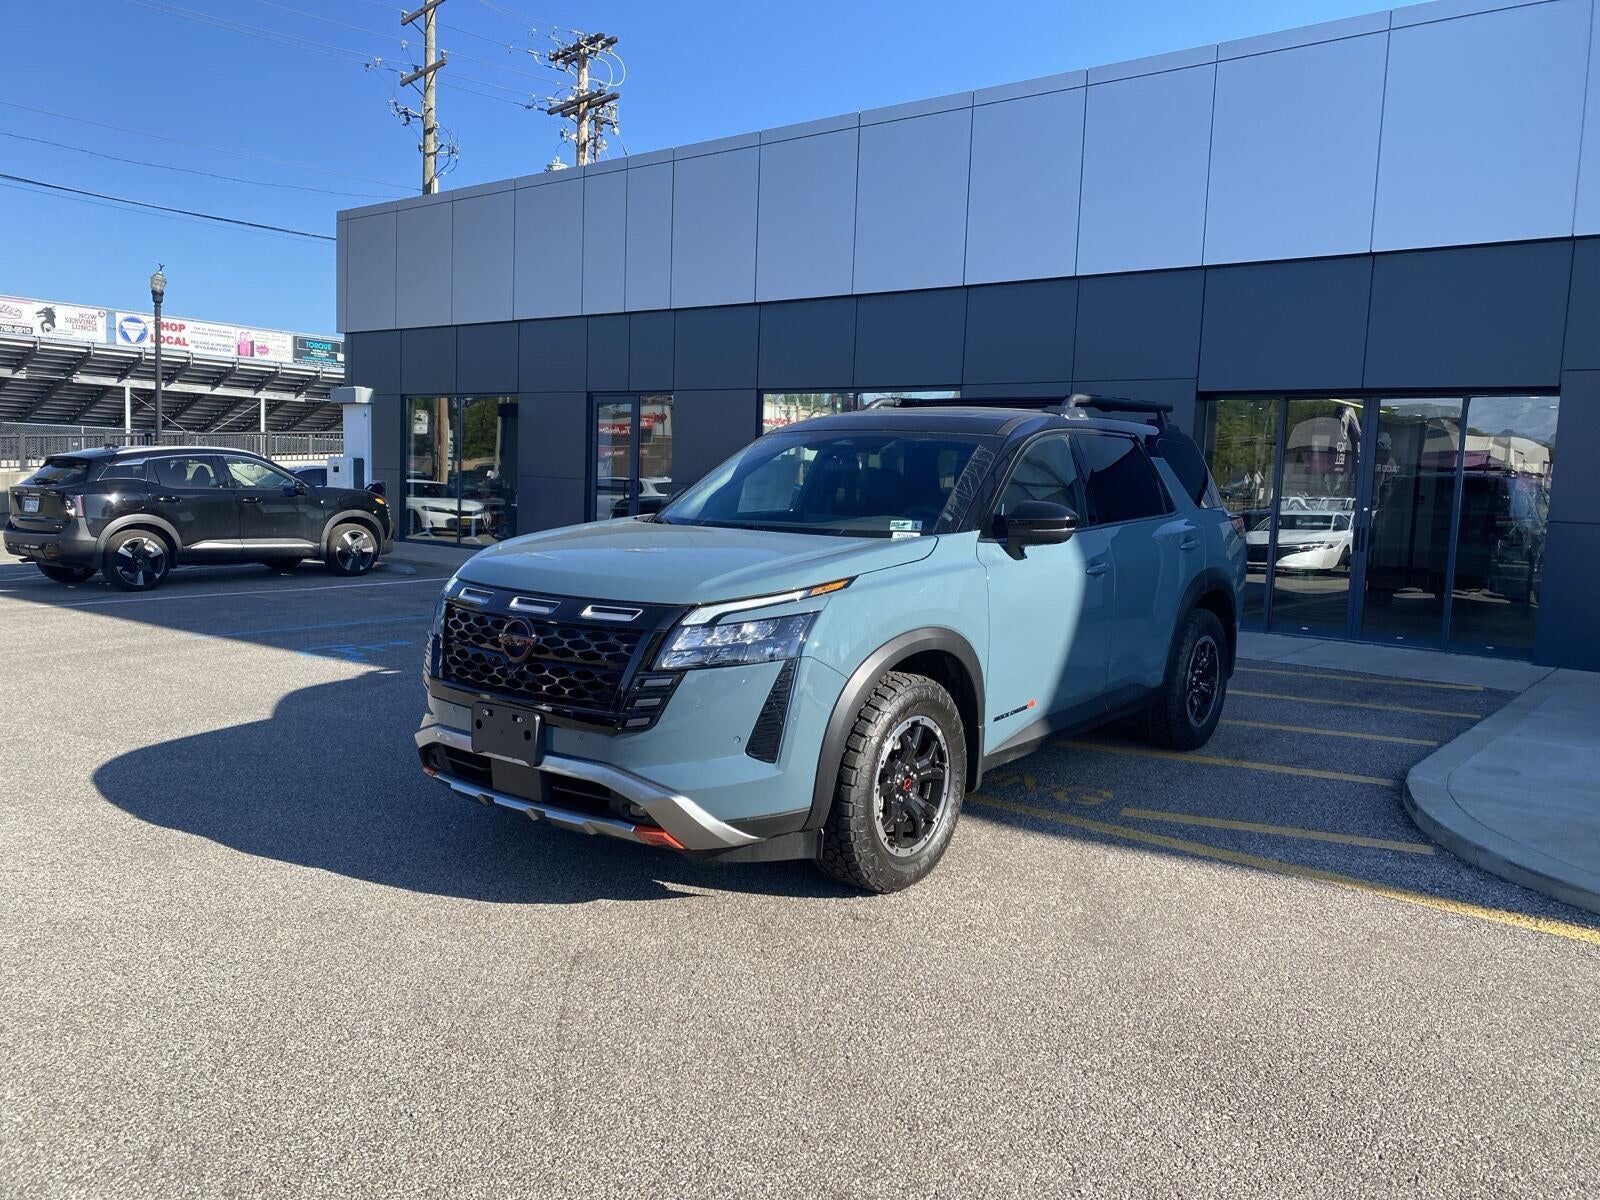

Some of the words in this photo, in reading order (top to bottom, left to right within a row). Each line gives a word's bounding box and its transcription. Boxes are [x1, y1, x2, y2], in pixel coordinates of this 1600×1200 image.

[78, 312, 97, 320] NOW
[64, 316, 97, 326] SERVING
[71, 323, 97, 332] LUNCH
[159, 321, 186, 333] HOP
[305, 341, 332, 350] TORQUE
